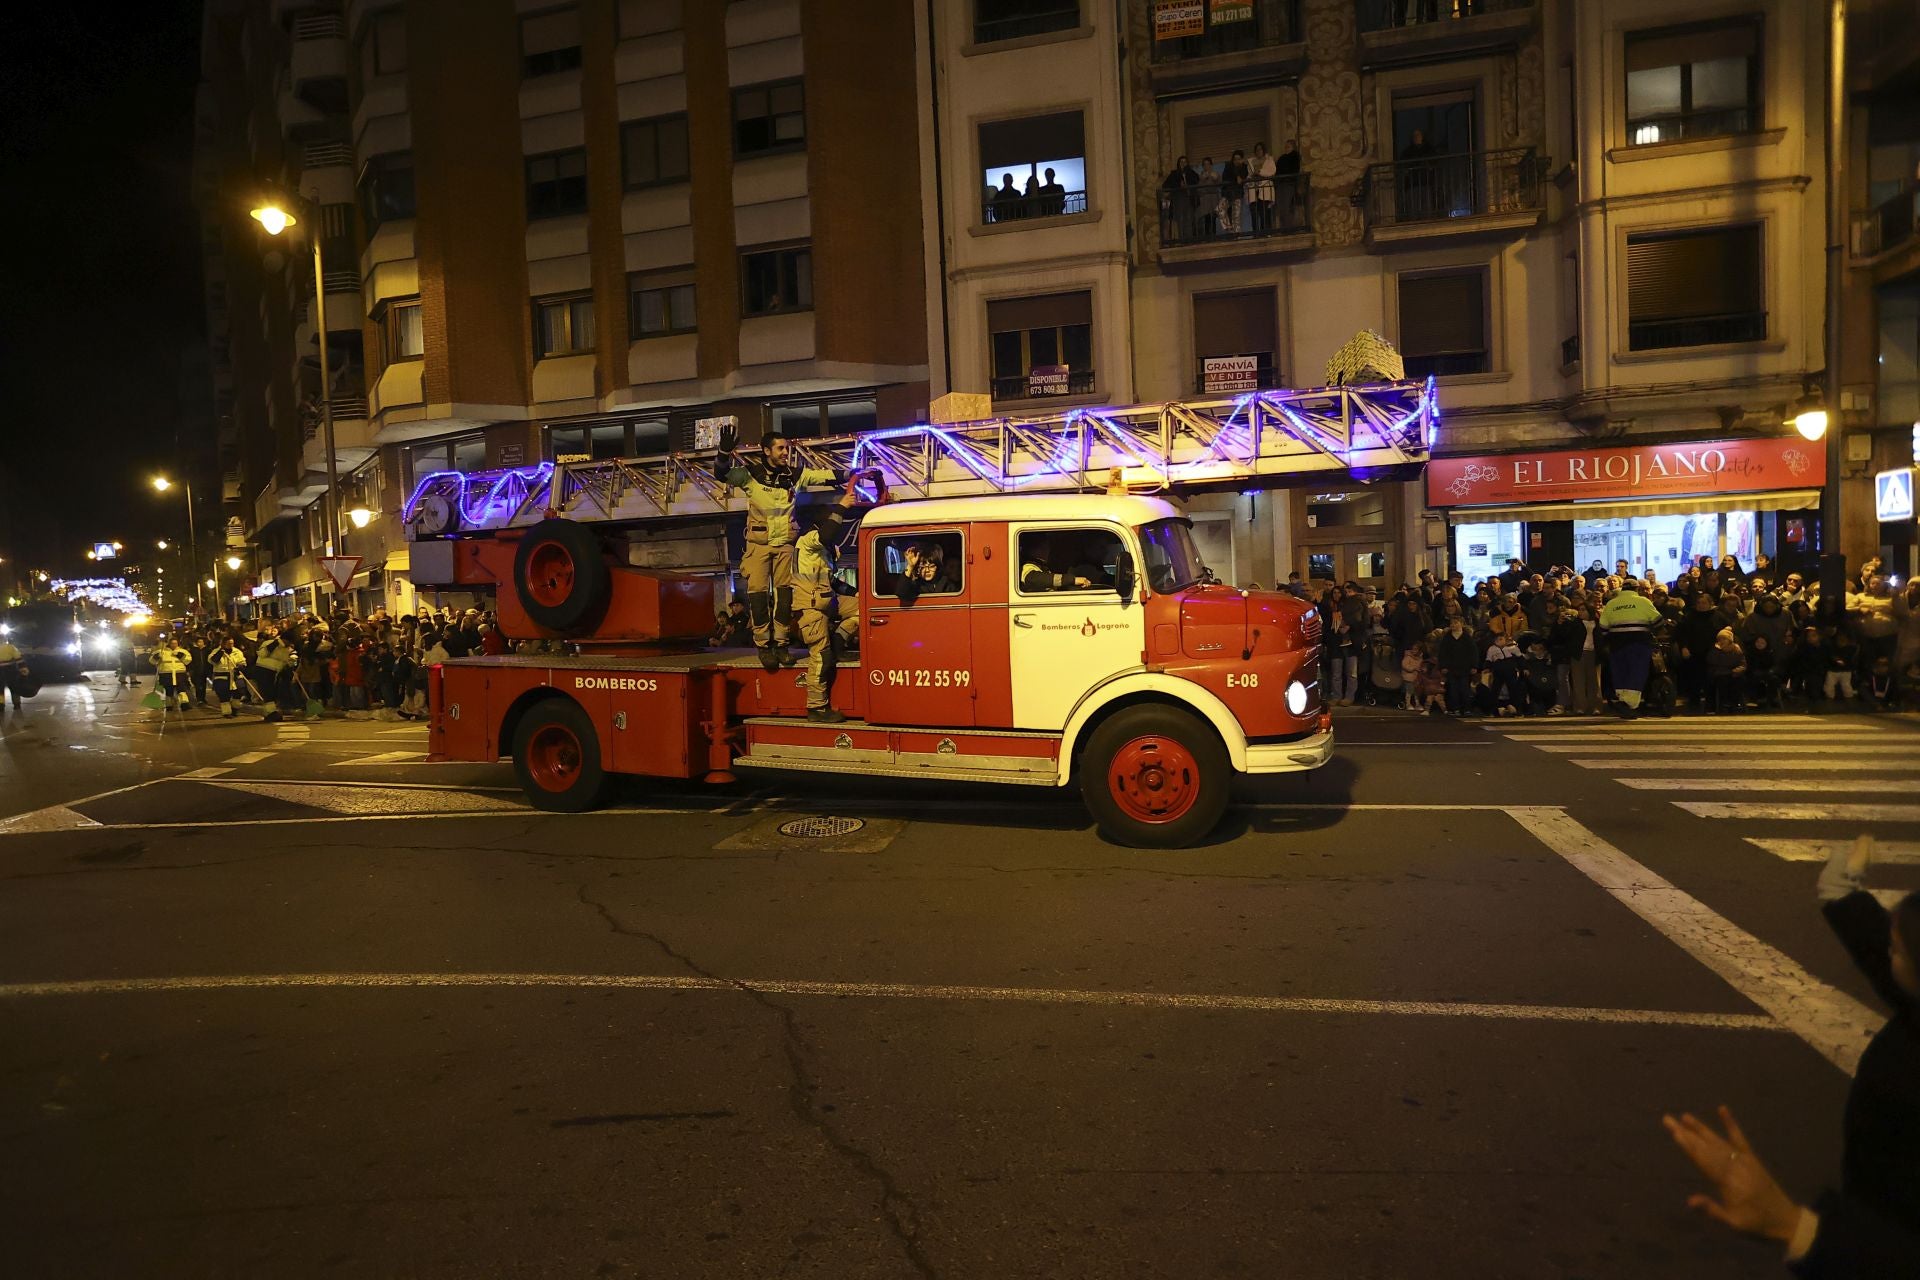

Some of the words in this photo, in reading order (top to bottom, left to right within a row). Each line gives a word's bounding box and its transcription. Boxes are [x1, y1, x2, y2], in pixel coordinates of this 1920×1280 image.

[1030, 374, 1067, 384] DISPONIBLE
[1210, 372, 1252, 380] VENDE
[1513, 460, 1553, 484] EL
[1568, 450, 1726, 485] RIOJANO
[1041, 623, 1081, 631] Bomberos
[575, 676, 657, 692] BOMBEROS
[888, 669, 910, 686] 941
[914, 669, 931, 687] 22
[934, 670, 950, 687] 55
[953, 670, 970, 687] 99
[1226, 673, 1259, 688] E-08
